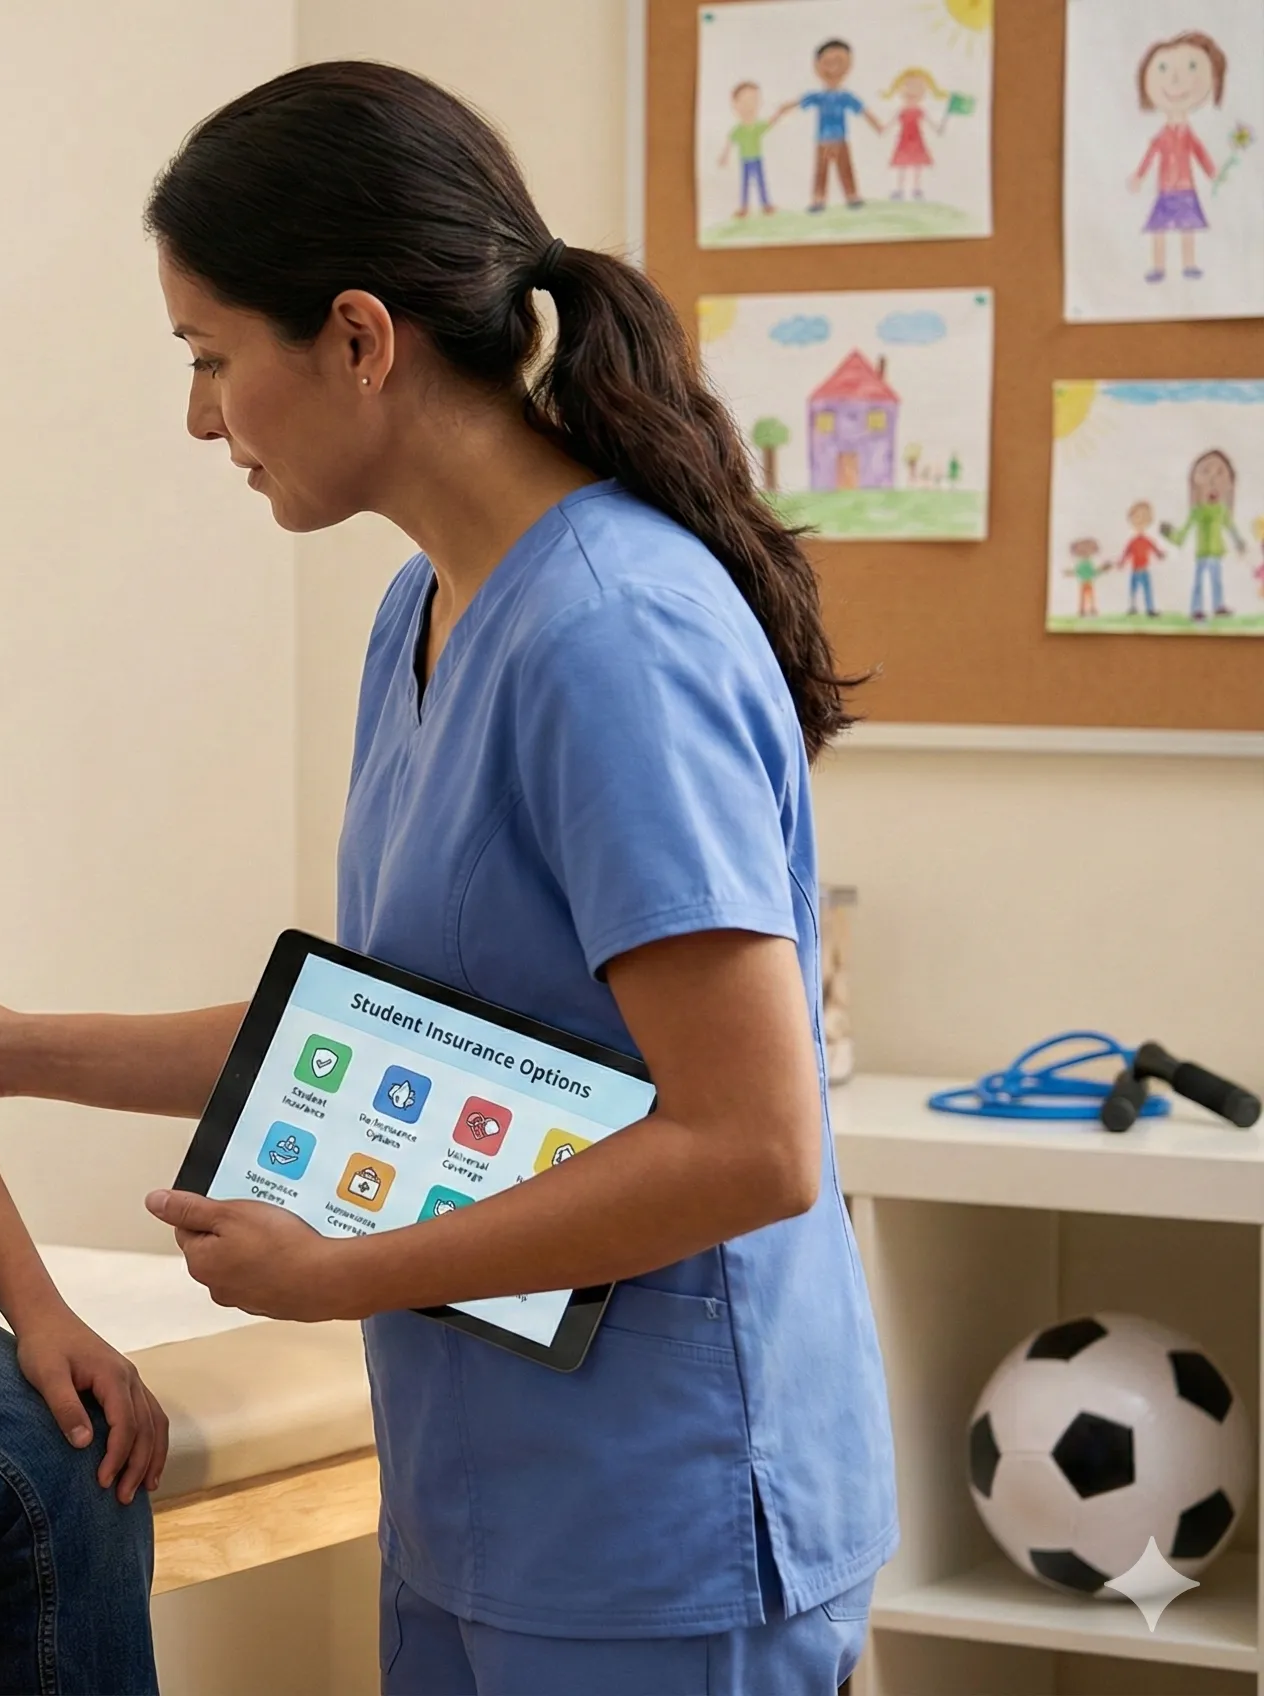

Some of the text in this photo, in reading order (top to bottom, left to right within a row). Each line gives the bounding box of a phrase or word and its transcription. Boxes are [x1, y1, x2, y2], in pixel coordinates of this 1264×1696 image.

[350, 993, 592, 1099] Student Insurance Options
